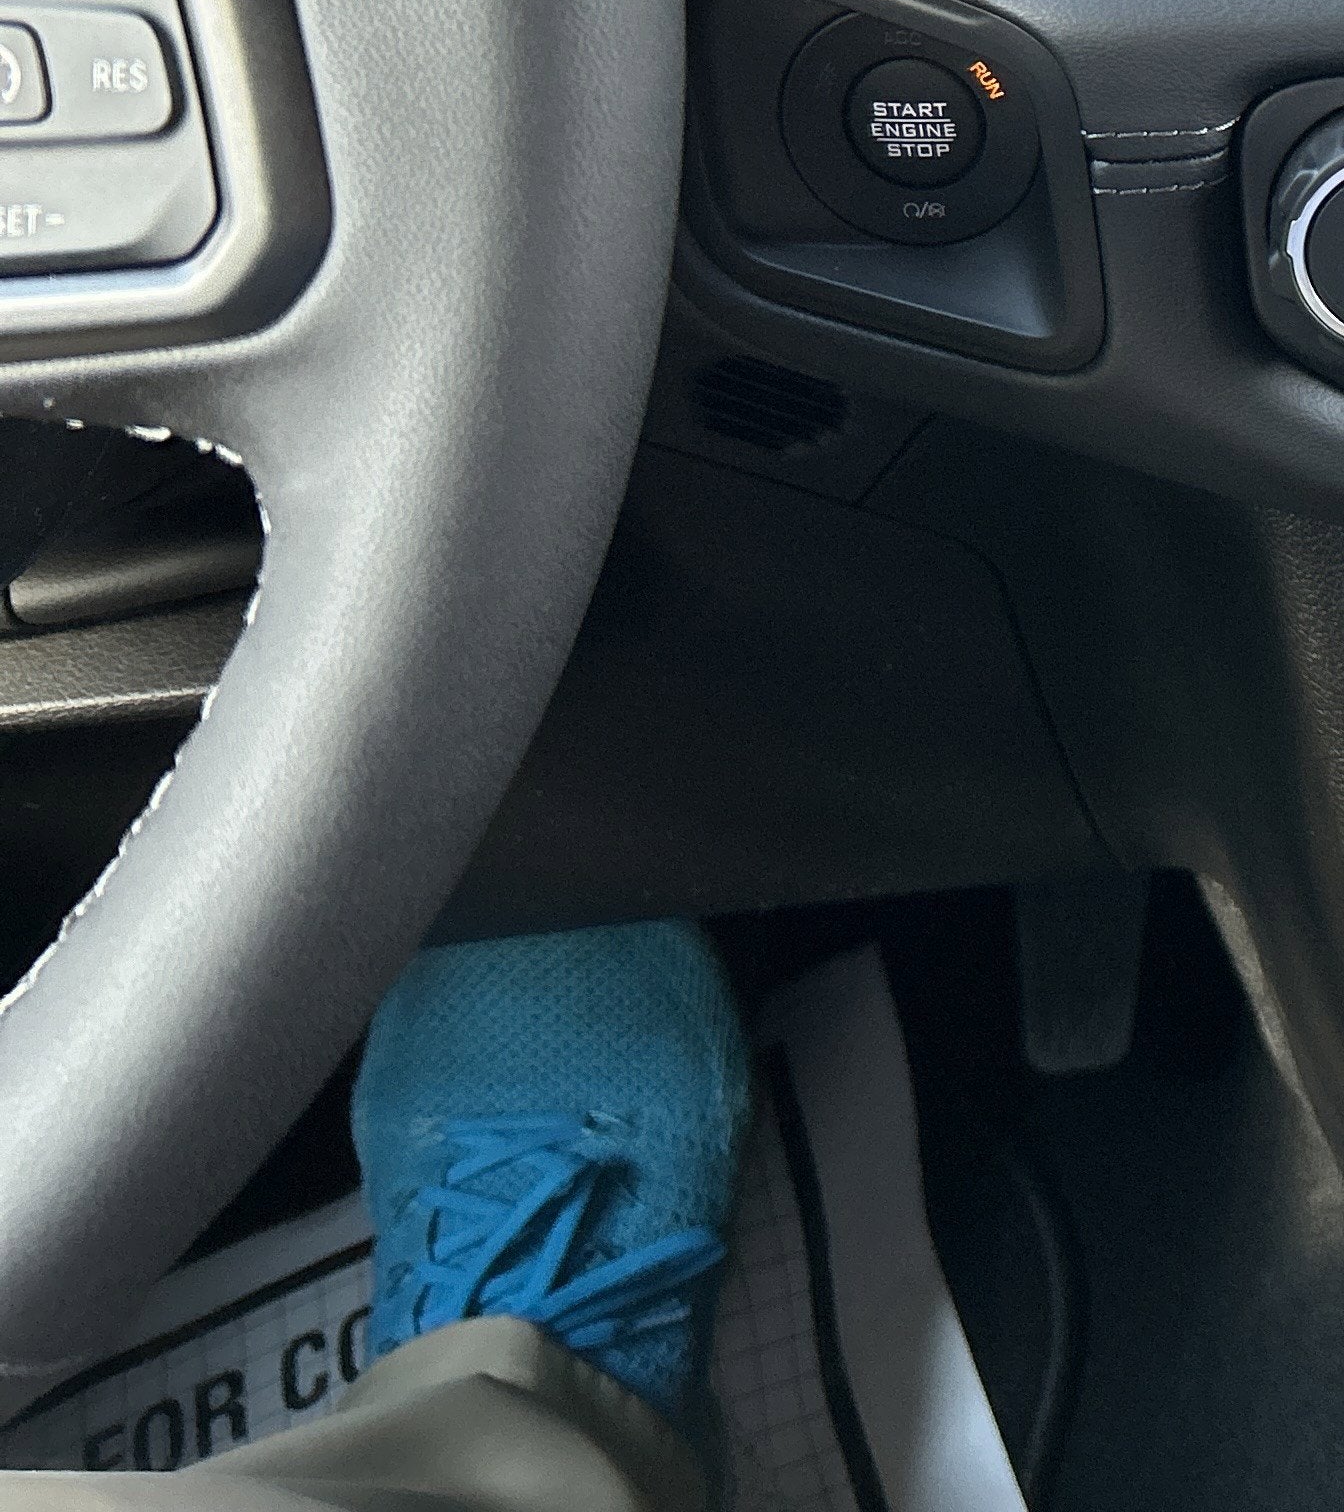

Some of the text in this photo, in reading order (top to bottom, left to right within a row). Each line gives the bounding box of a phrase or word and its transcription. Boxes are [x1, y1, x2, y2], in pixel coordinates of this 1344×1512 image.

[91, 58, 148, 93] RES
[968, 61, 1004, 101] RUN
[873, 102, 947, 117] START
[870, 123, 957, 138] ENGINE
[887, 143, 950, 157] STOP
